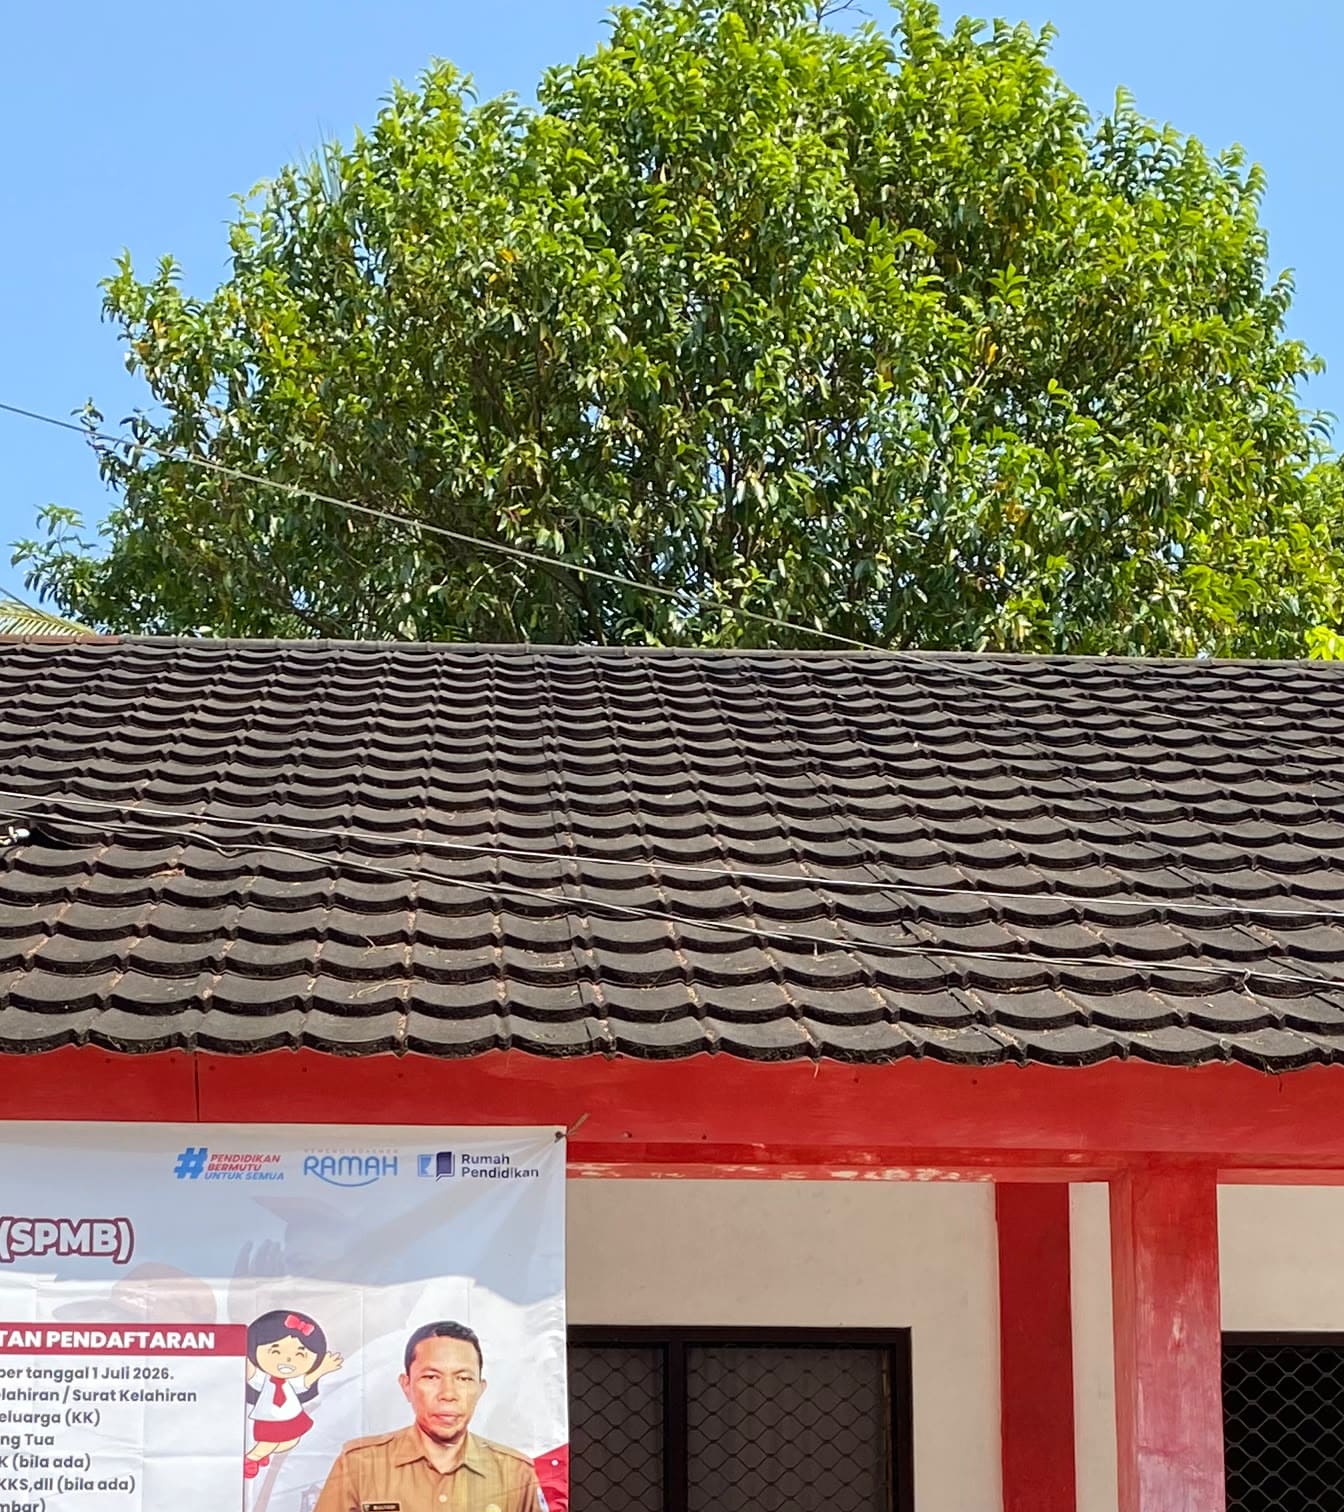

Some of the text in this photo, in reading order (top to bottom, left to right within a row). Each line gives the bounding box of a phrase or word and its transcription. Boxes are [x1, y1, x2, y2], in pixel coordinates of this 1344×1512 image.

[208, 1163, 262, 1171] BERMUTU
[210, 1154, 281, 1163] PENDIDIKAN
[461, 1153, 510, 1165] Rumah
[204, 1172, 284, 1180] UNTUK SEMUA
[304, 1155, 398, 1180] RAMAH
[461, 1166, 539, 1179] Pendidikan
[46, 1330, 214, 1349] PENDAFTARAN
[26, 1366, 89, 1383] tanggal
[92, 1367, 98, 1379] 1
[101, 1366, 130, 1380] Juli
[133, 1367, 174, 1380] 2026.
[62, 1385, 70, 1404] /
[72, 1389, 117, 1401] Surat
[119, 1389, 197, 1402] Kelahiran
[65, 1408, 100, 1427] (KK)
[25, 1434, 55, 1446] Tua
[12, 1455, 49, 1473] (bila
[52, 1455, 91, 1472] ada)
[56, 1476, 95, 1495] (bila
[98, 1476, 135, 1494] ada)
